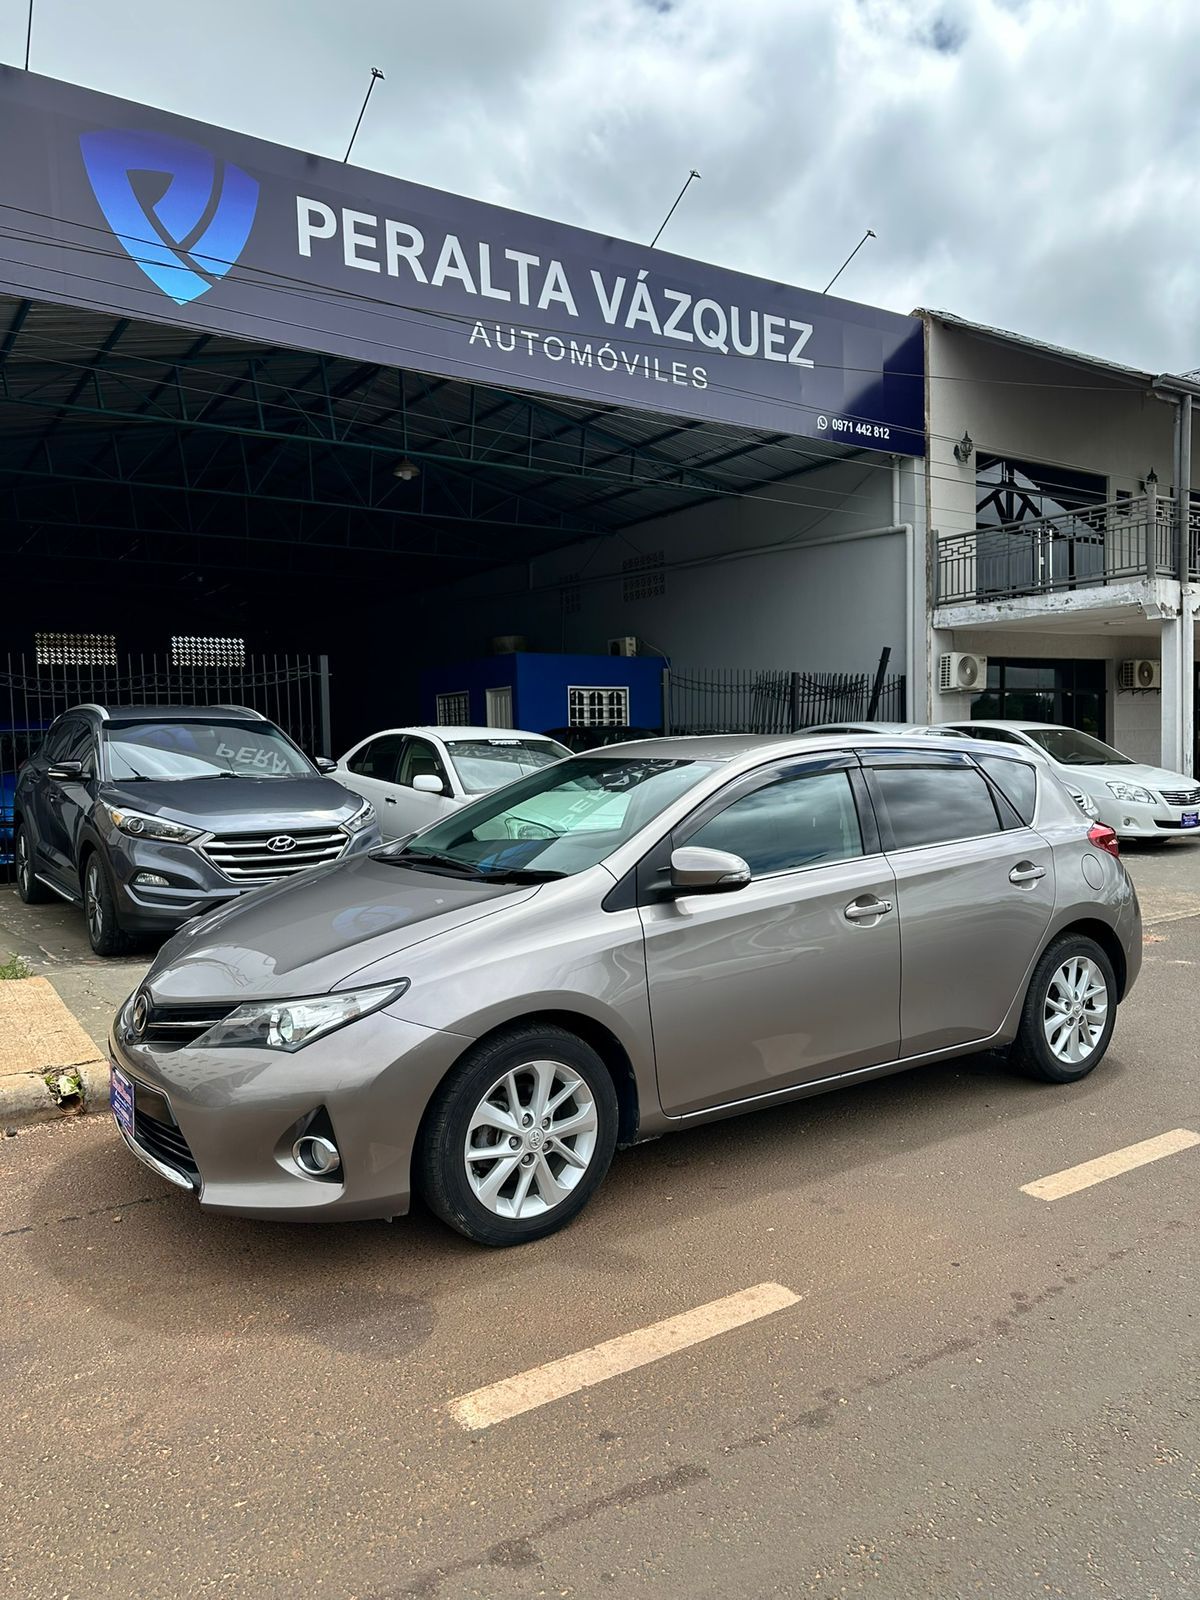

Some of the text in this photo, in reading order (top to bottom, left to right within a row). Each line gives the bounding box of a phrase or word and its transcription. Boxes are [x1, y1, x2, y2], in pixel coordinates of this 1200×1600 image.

[296, 195, 815, 369] PERALTA VÁZQUEZ
[469, 321, 708, 390] AUTOMÓVILES
[832, 418, 890, 440] 0971 442 812
